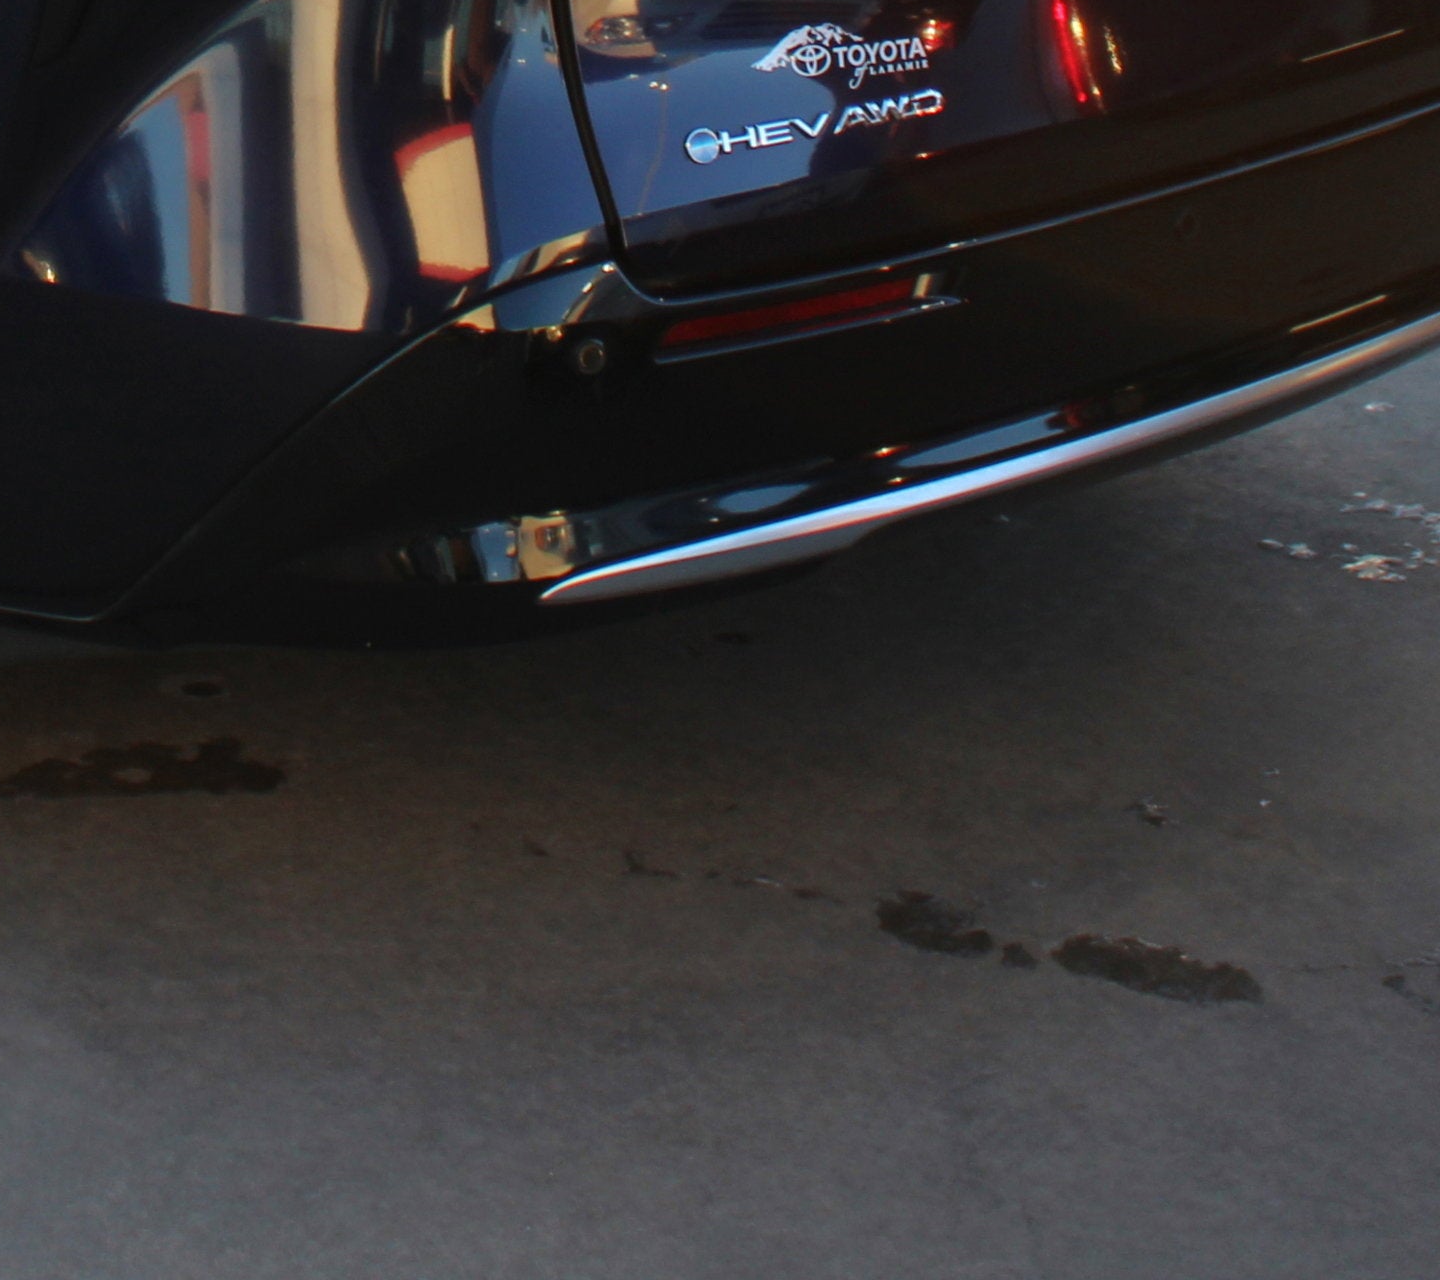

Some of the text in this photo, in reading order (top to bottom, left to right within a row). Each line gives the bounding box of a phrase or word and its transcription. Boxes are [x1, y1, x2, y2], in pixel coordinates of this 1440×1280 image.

[832, 37, 927, 68] TOYOTA
[849, 59, 929, 90] of LARAMIE
[720, 88, 945, 153] HEV AWD
